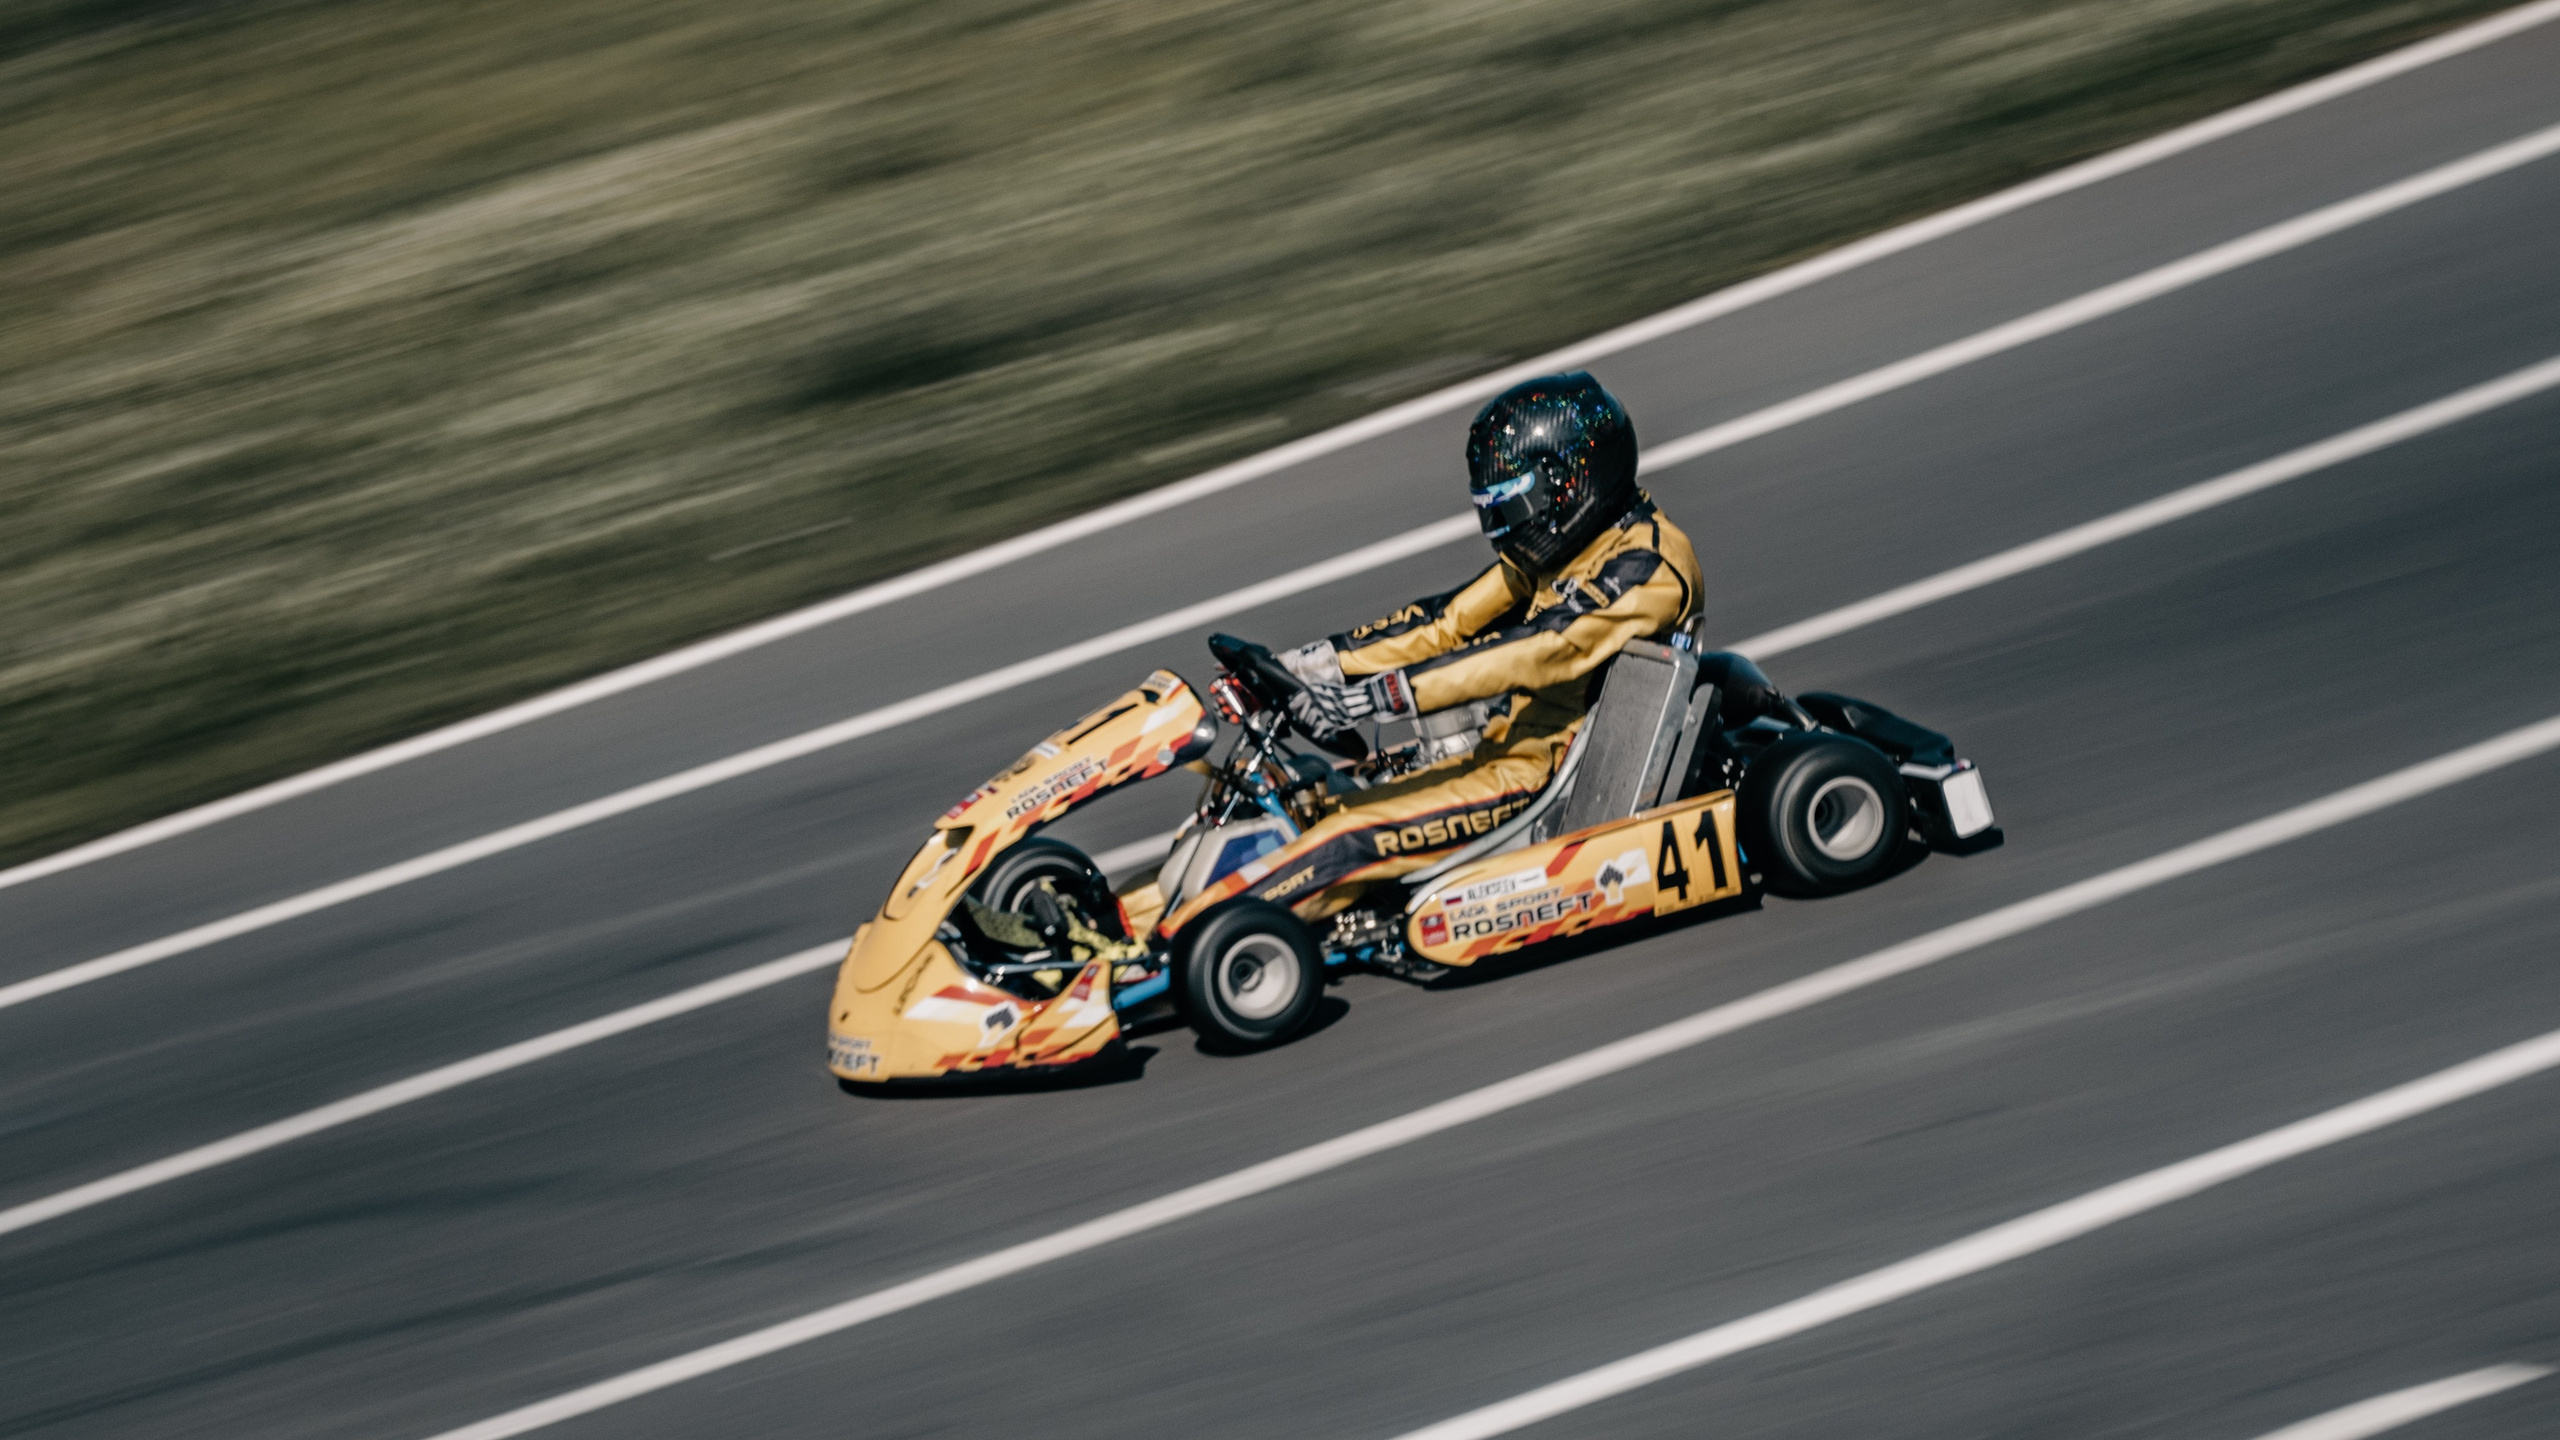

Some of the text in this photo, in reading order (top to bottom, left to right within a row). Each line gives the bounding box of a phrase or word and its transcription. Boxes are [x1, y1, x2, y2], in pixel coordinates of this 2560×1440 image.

[1006, 758, 1108, 819] ROSNEFT
[1656, 808, 1728, 901] 41
[1261, 864, 1315, 902] PORT
[1452, 887, 1562, 921] LADA SPORT
[1453, 892, 1594, 941] ROSNEFT
